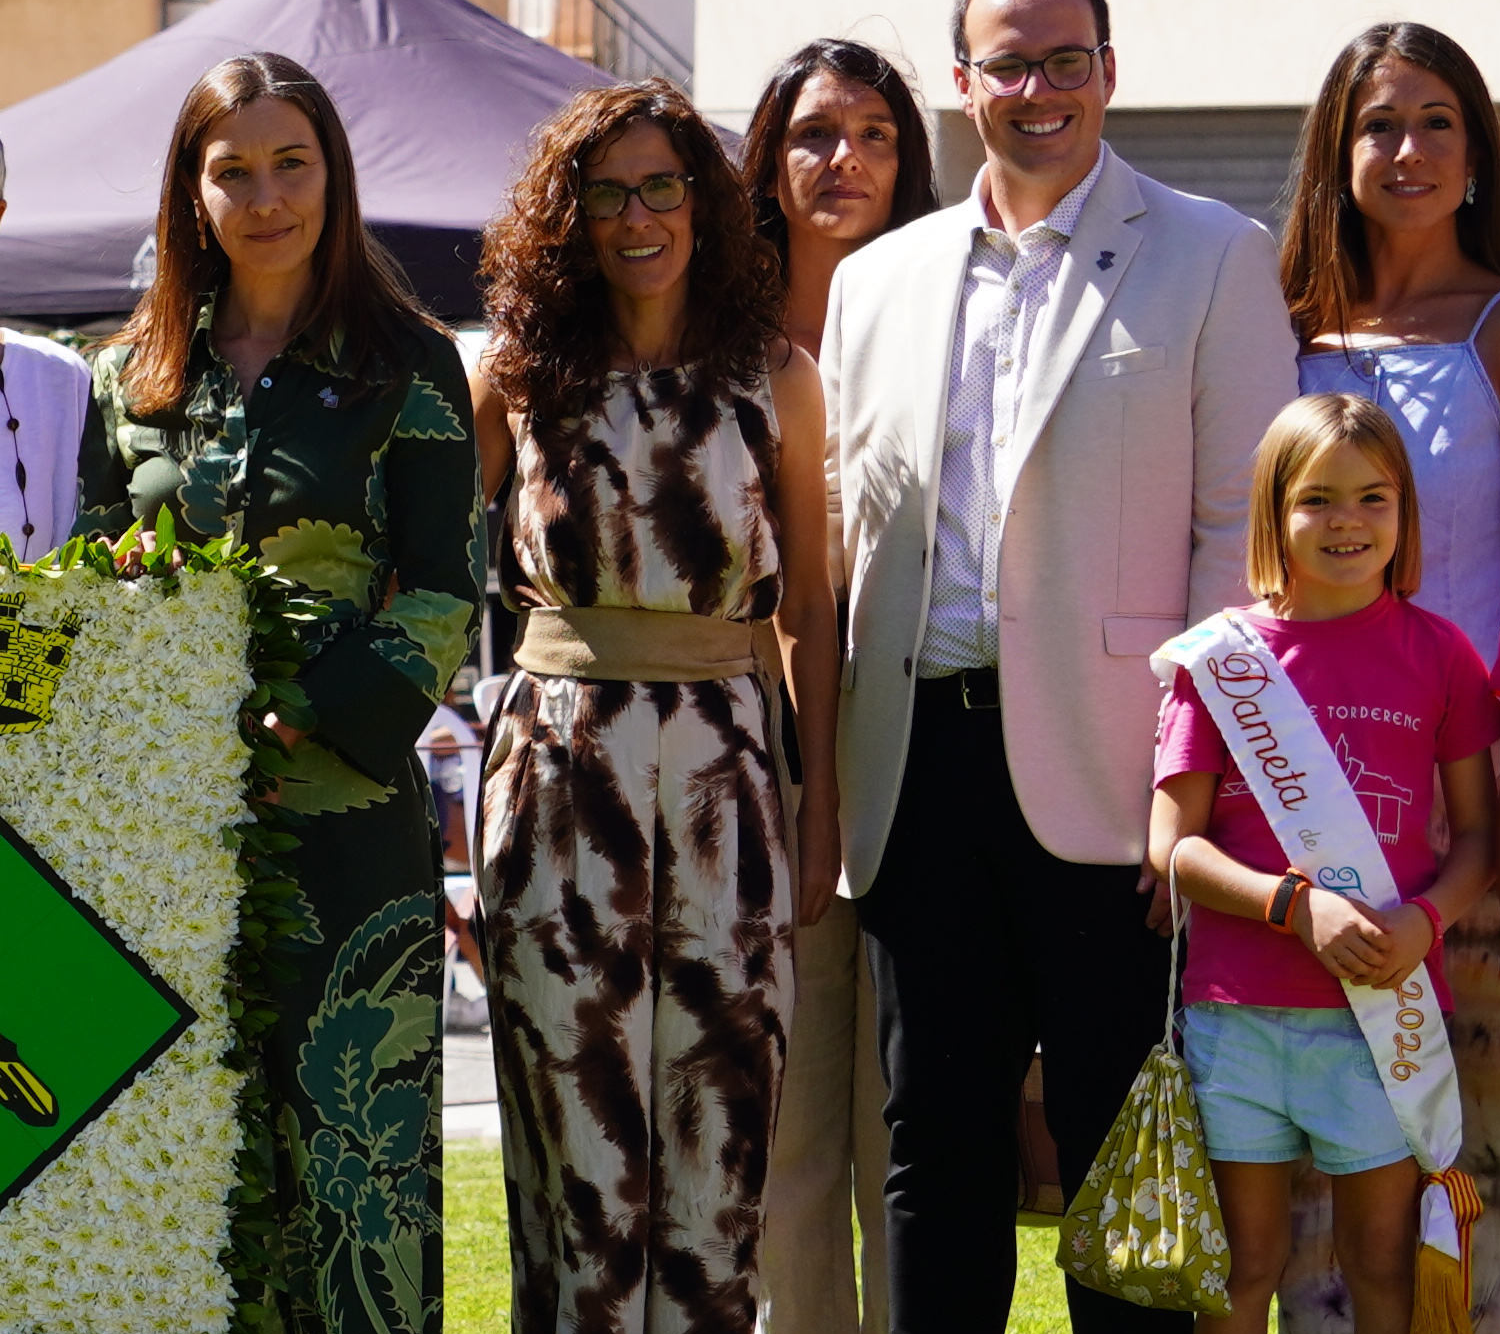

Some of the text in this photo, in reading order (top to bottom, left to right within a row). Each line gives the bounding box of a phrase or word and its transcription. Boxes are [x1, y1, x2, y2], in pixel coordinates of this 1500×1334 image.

[1207, 652, 1308, 811] Dameta
[1327, 705, 1422, 731] TORDERENC
[1298, 829, 1321, 852] de
[1390, 981, 1425, 1081] 2026
